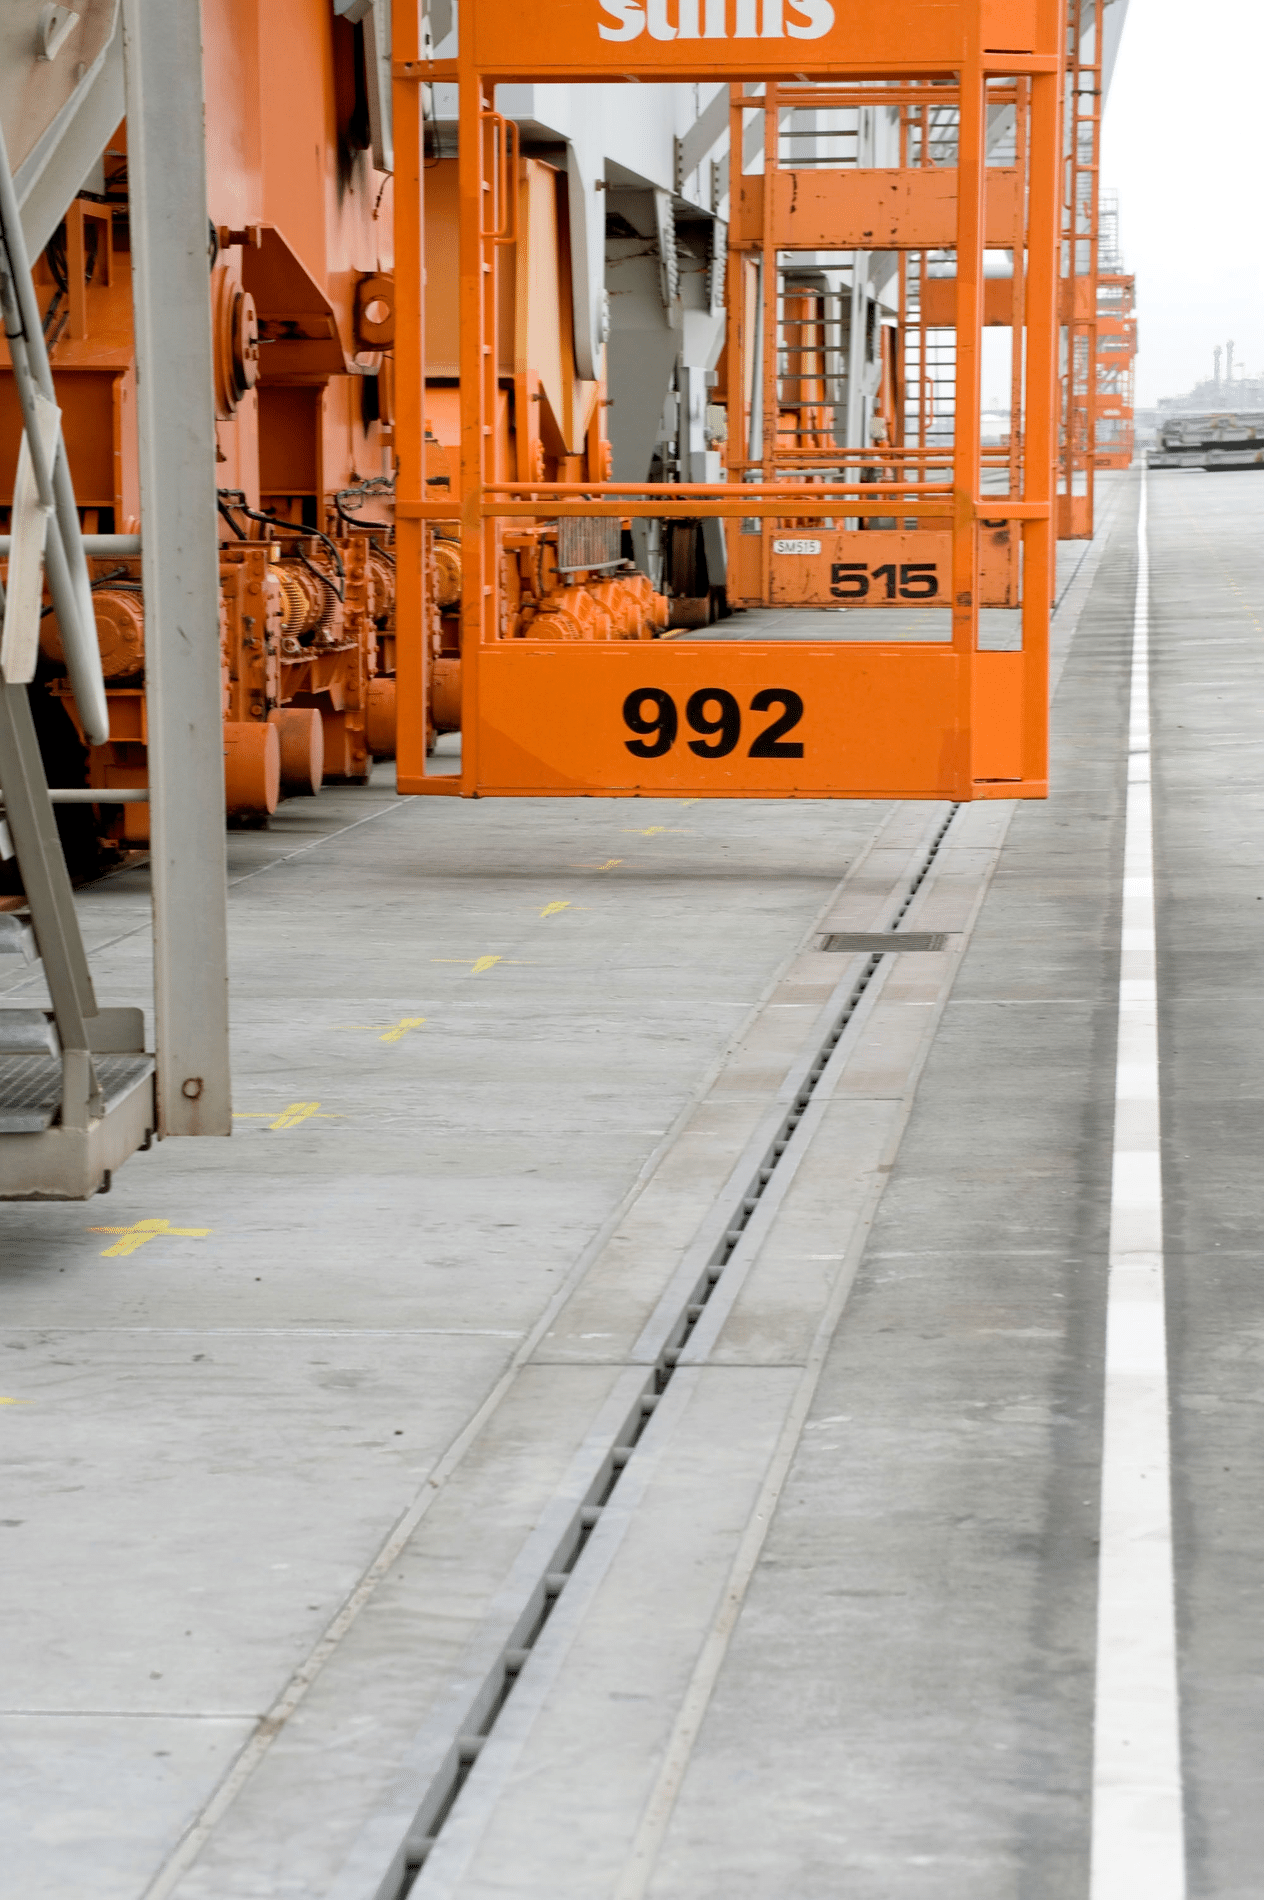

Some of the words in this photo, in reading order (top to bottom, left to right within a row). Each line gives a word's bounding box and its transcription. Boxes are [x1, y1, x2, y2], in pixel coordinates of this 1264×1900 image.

[777, 541, 816, 553] SM515
[830, 563, 938, 599] 515
[622, 687, 805, 759] 992
